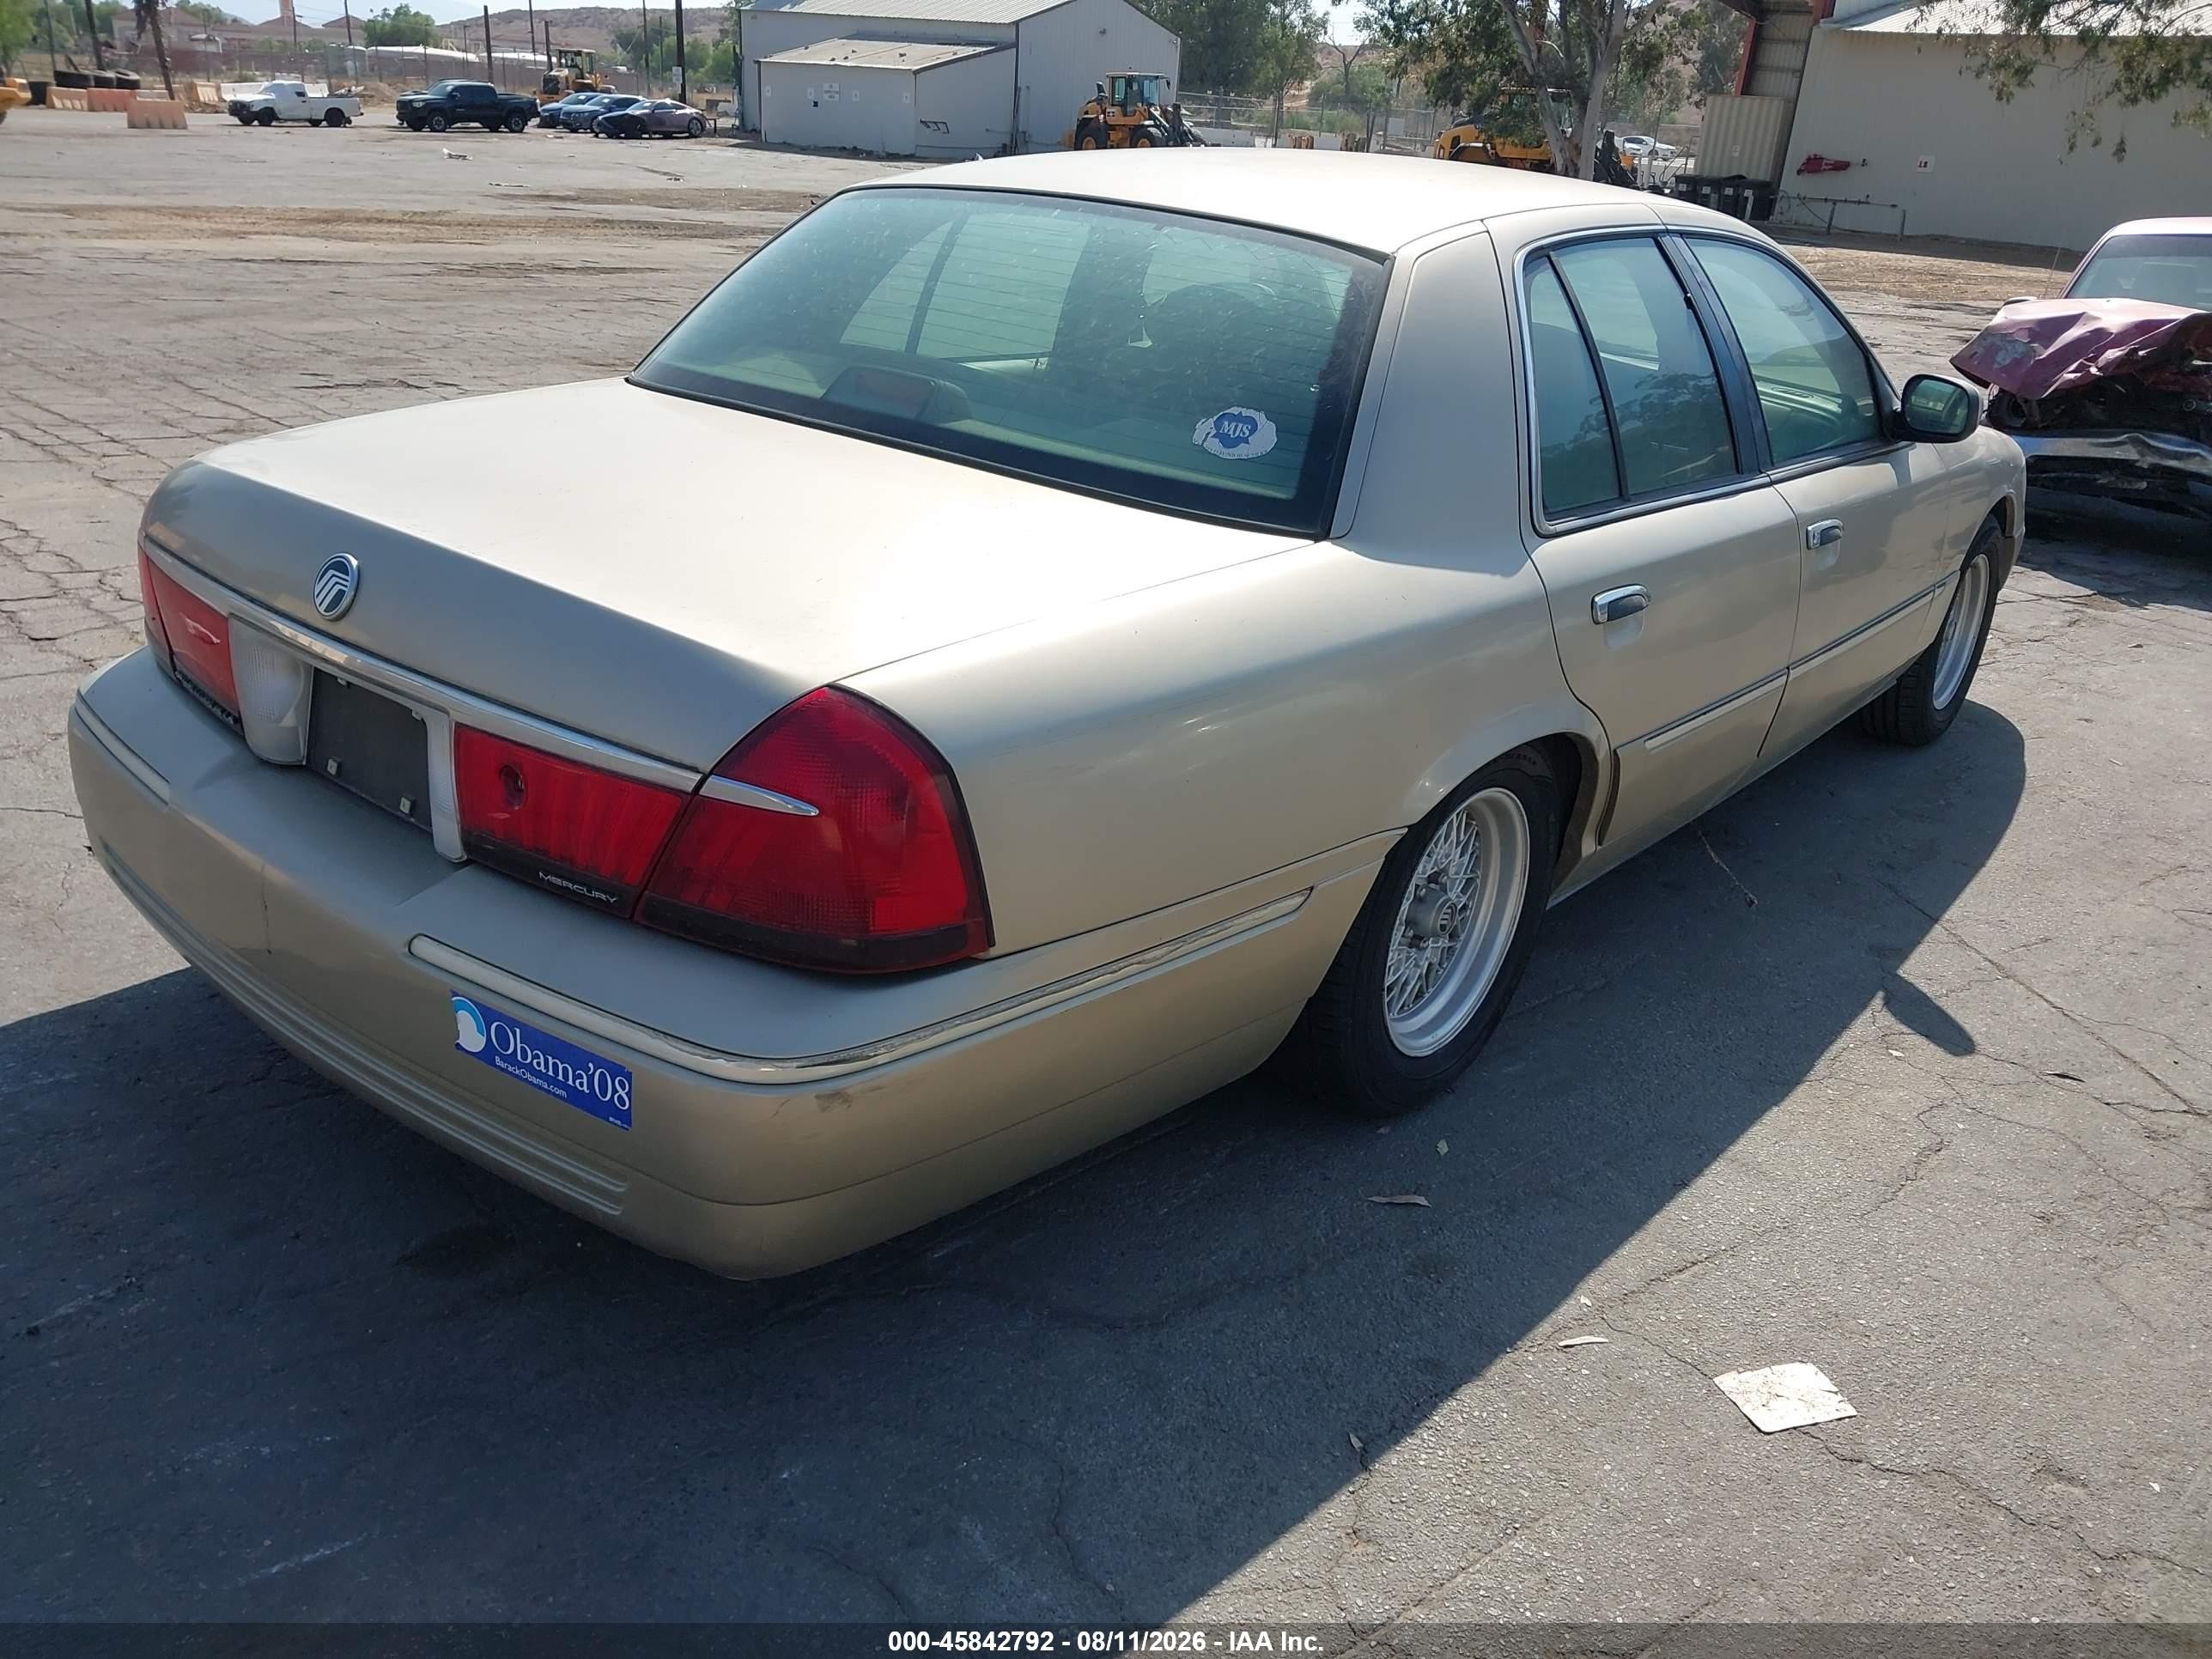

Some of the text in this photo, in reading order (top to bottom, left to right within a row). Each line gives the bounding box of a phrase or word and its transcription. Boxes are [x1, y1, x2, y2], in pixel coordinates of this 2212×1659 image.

[1219, 421, 1251, 438] MJS
[538, 872, 618, 904] MERCURY
[495, 1055, 568, 1099] BarackObama.com
